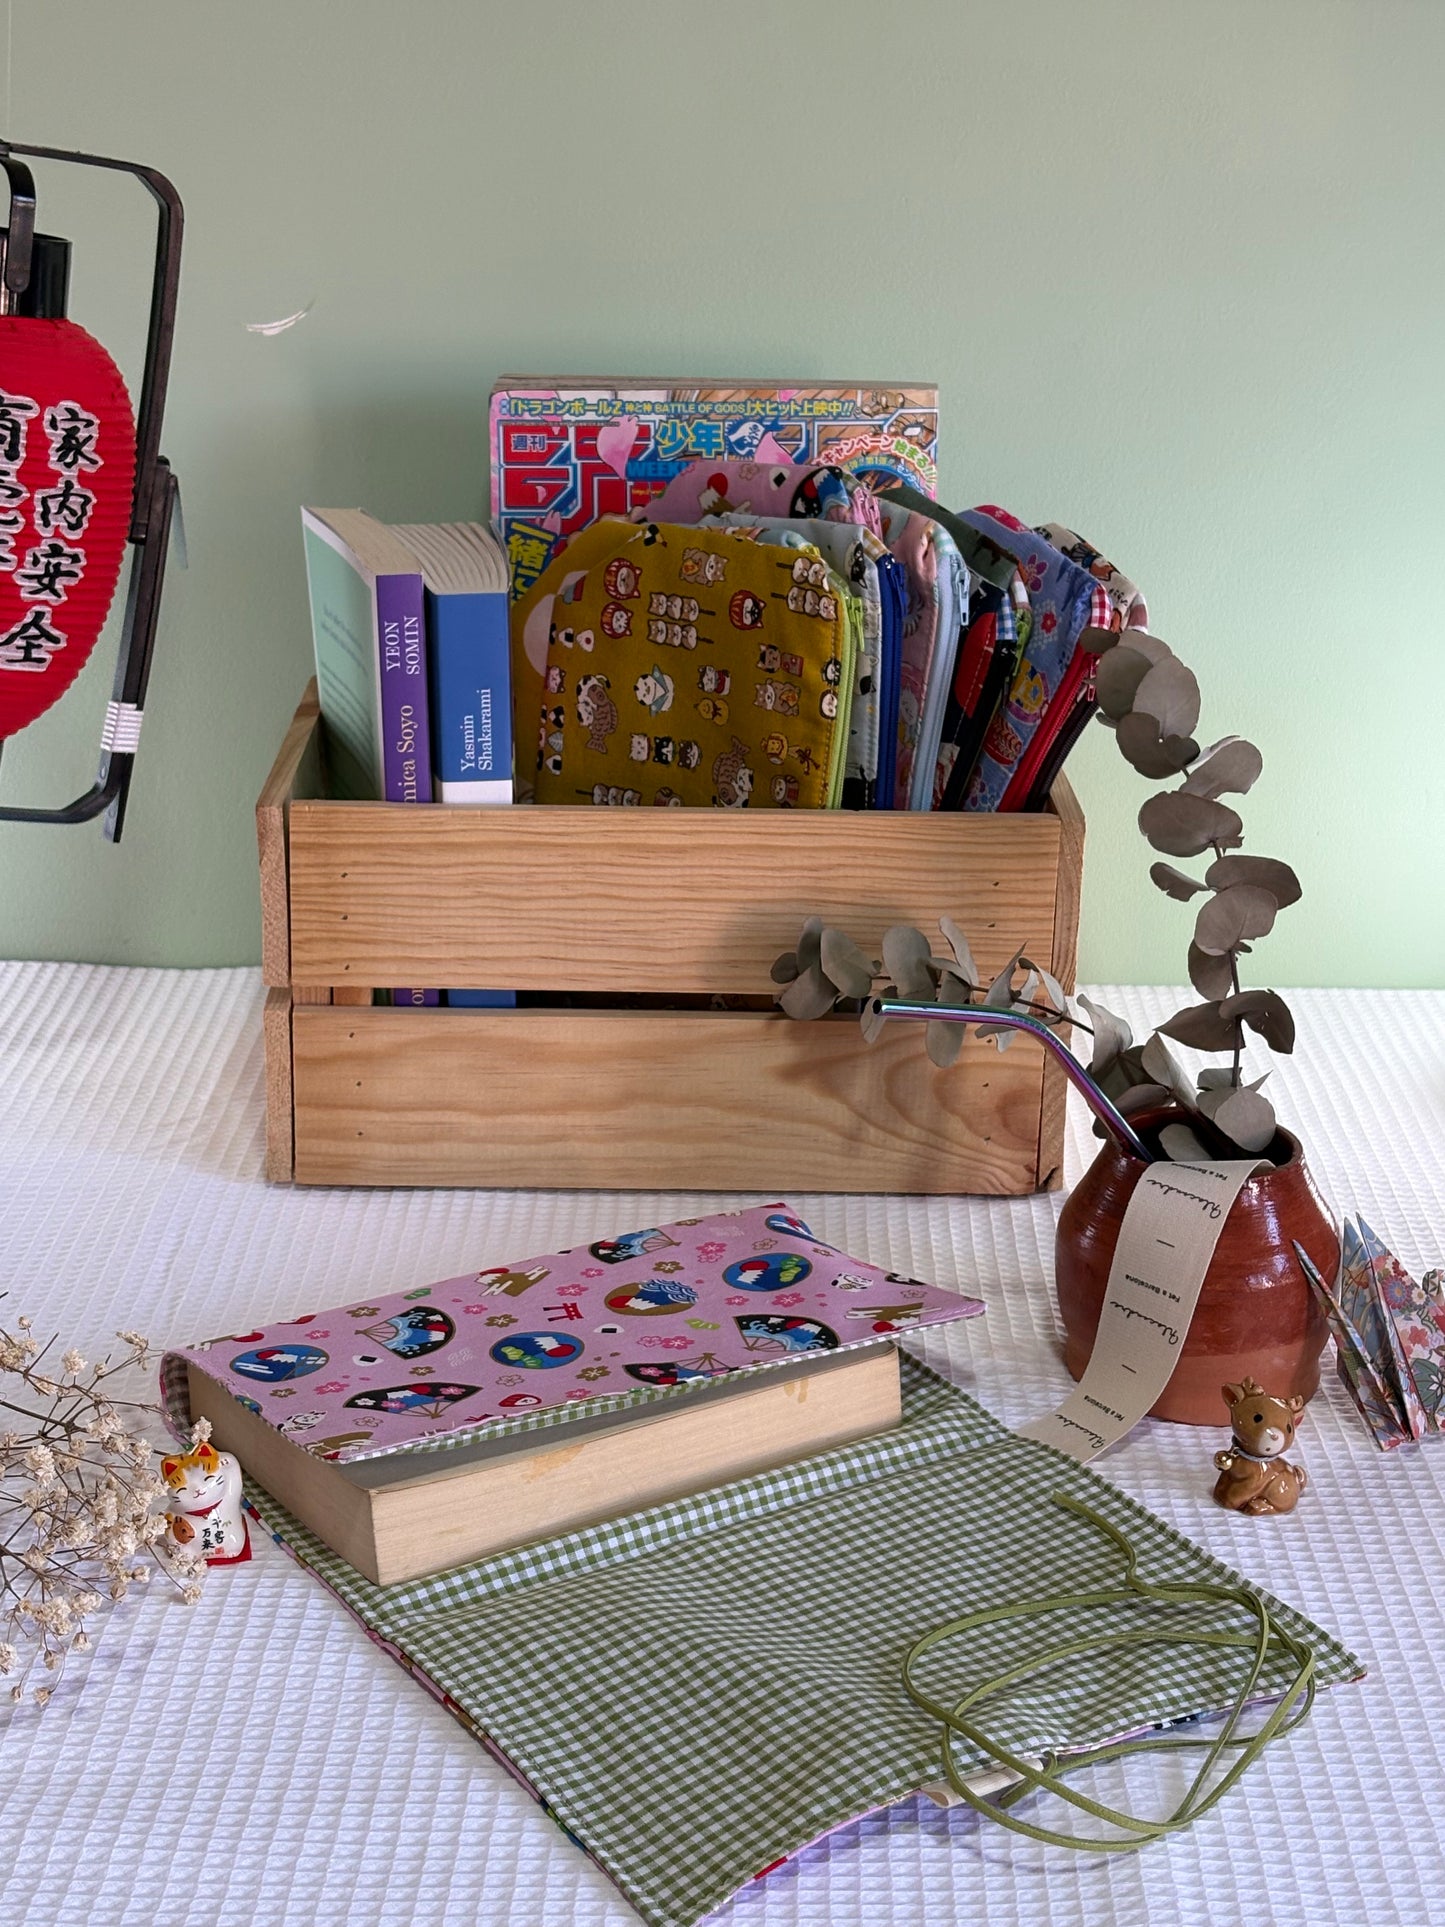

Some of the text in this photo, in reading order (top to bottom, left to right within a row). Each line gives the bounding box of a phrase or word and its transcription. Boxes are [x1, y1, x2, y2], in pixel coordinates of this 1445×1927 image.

[655, 403, 695, 413] BATTLE
[697, 403, 713, 413] OF
[511, 433, 547, 453] 週刊
[655, 419, 726, 459] 少年
[0, 402, 102, 666] 家内安全
[384, 620, 401, 673] YEON
[403, 615, 421, 676] SOMIN
[396, 704, 418, 753] Soyo
[459, 714, 476, 772] Yasmin
[475, 687, 493, 771] Shakarami
[1124, 1273, 1161, 1295] Barcelona
[1168, 1291, 1181, 1303] Fet
[201, 1528, 215, 1551] 万来
